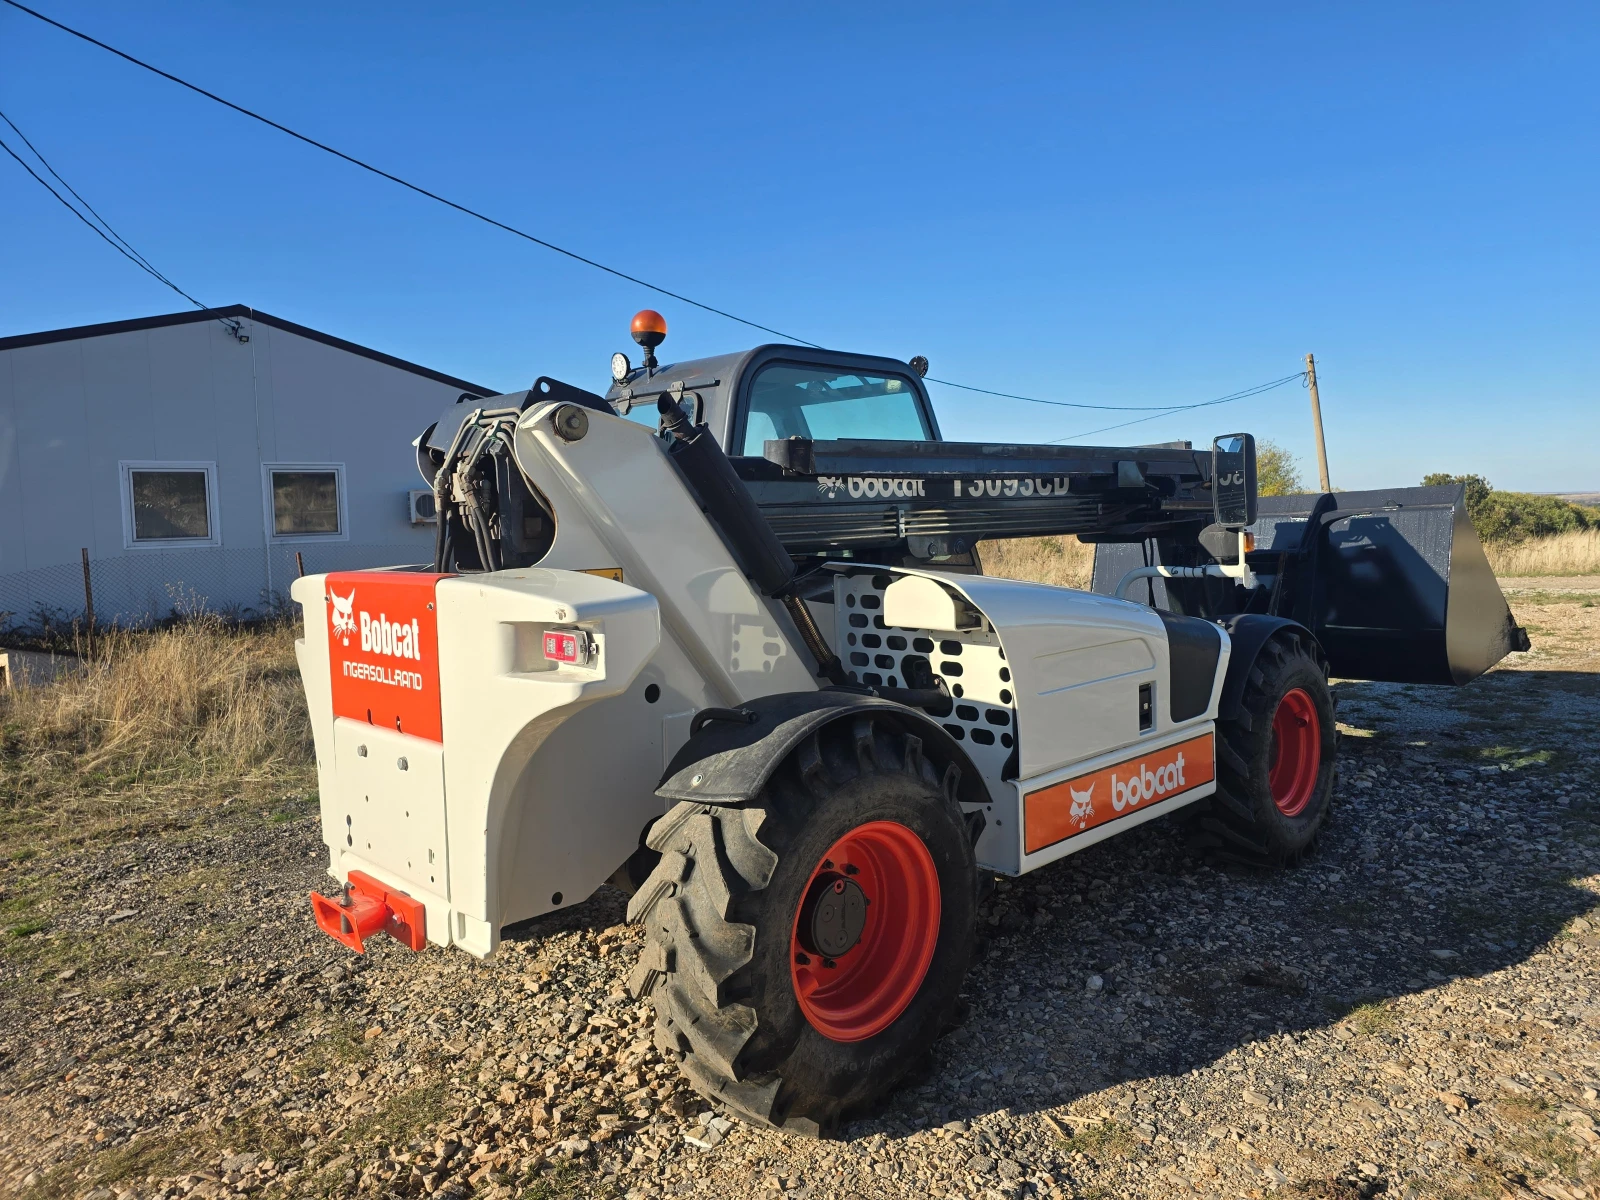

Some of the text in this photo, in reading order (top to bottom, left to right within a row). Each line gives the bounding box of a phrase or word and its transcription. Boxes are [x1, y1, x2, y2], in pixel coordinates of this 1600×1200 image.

[847, 476, 926, 499] bobcat
[359, 611, 421, 660] Bobcat
[1111, 751, 1186, 812] bobcat
